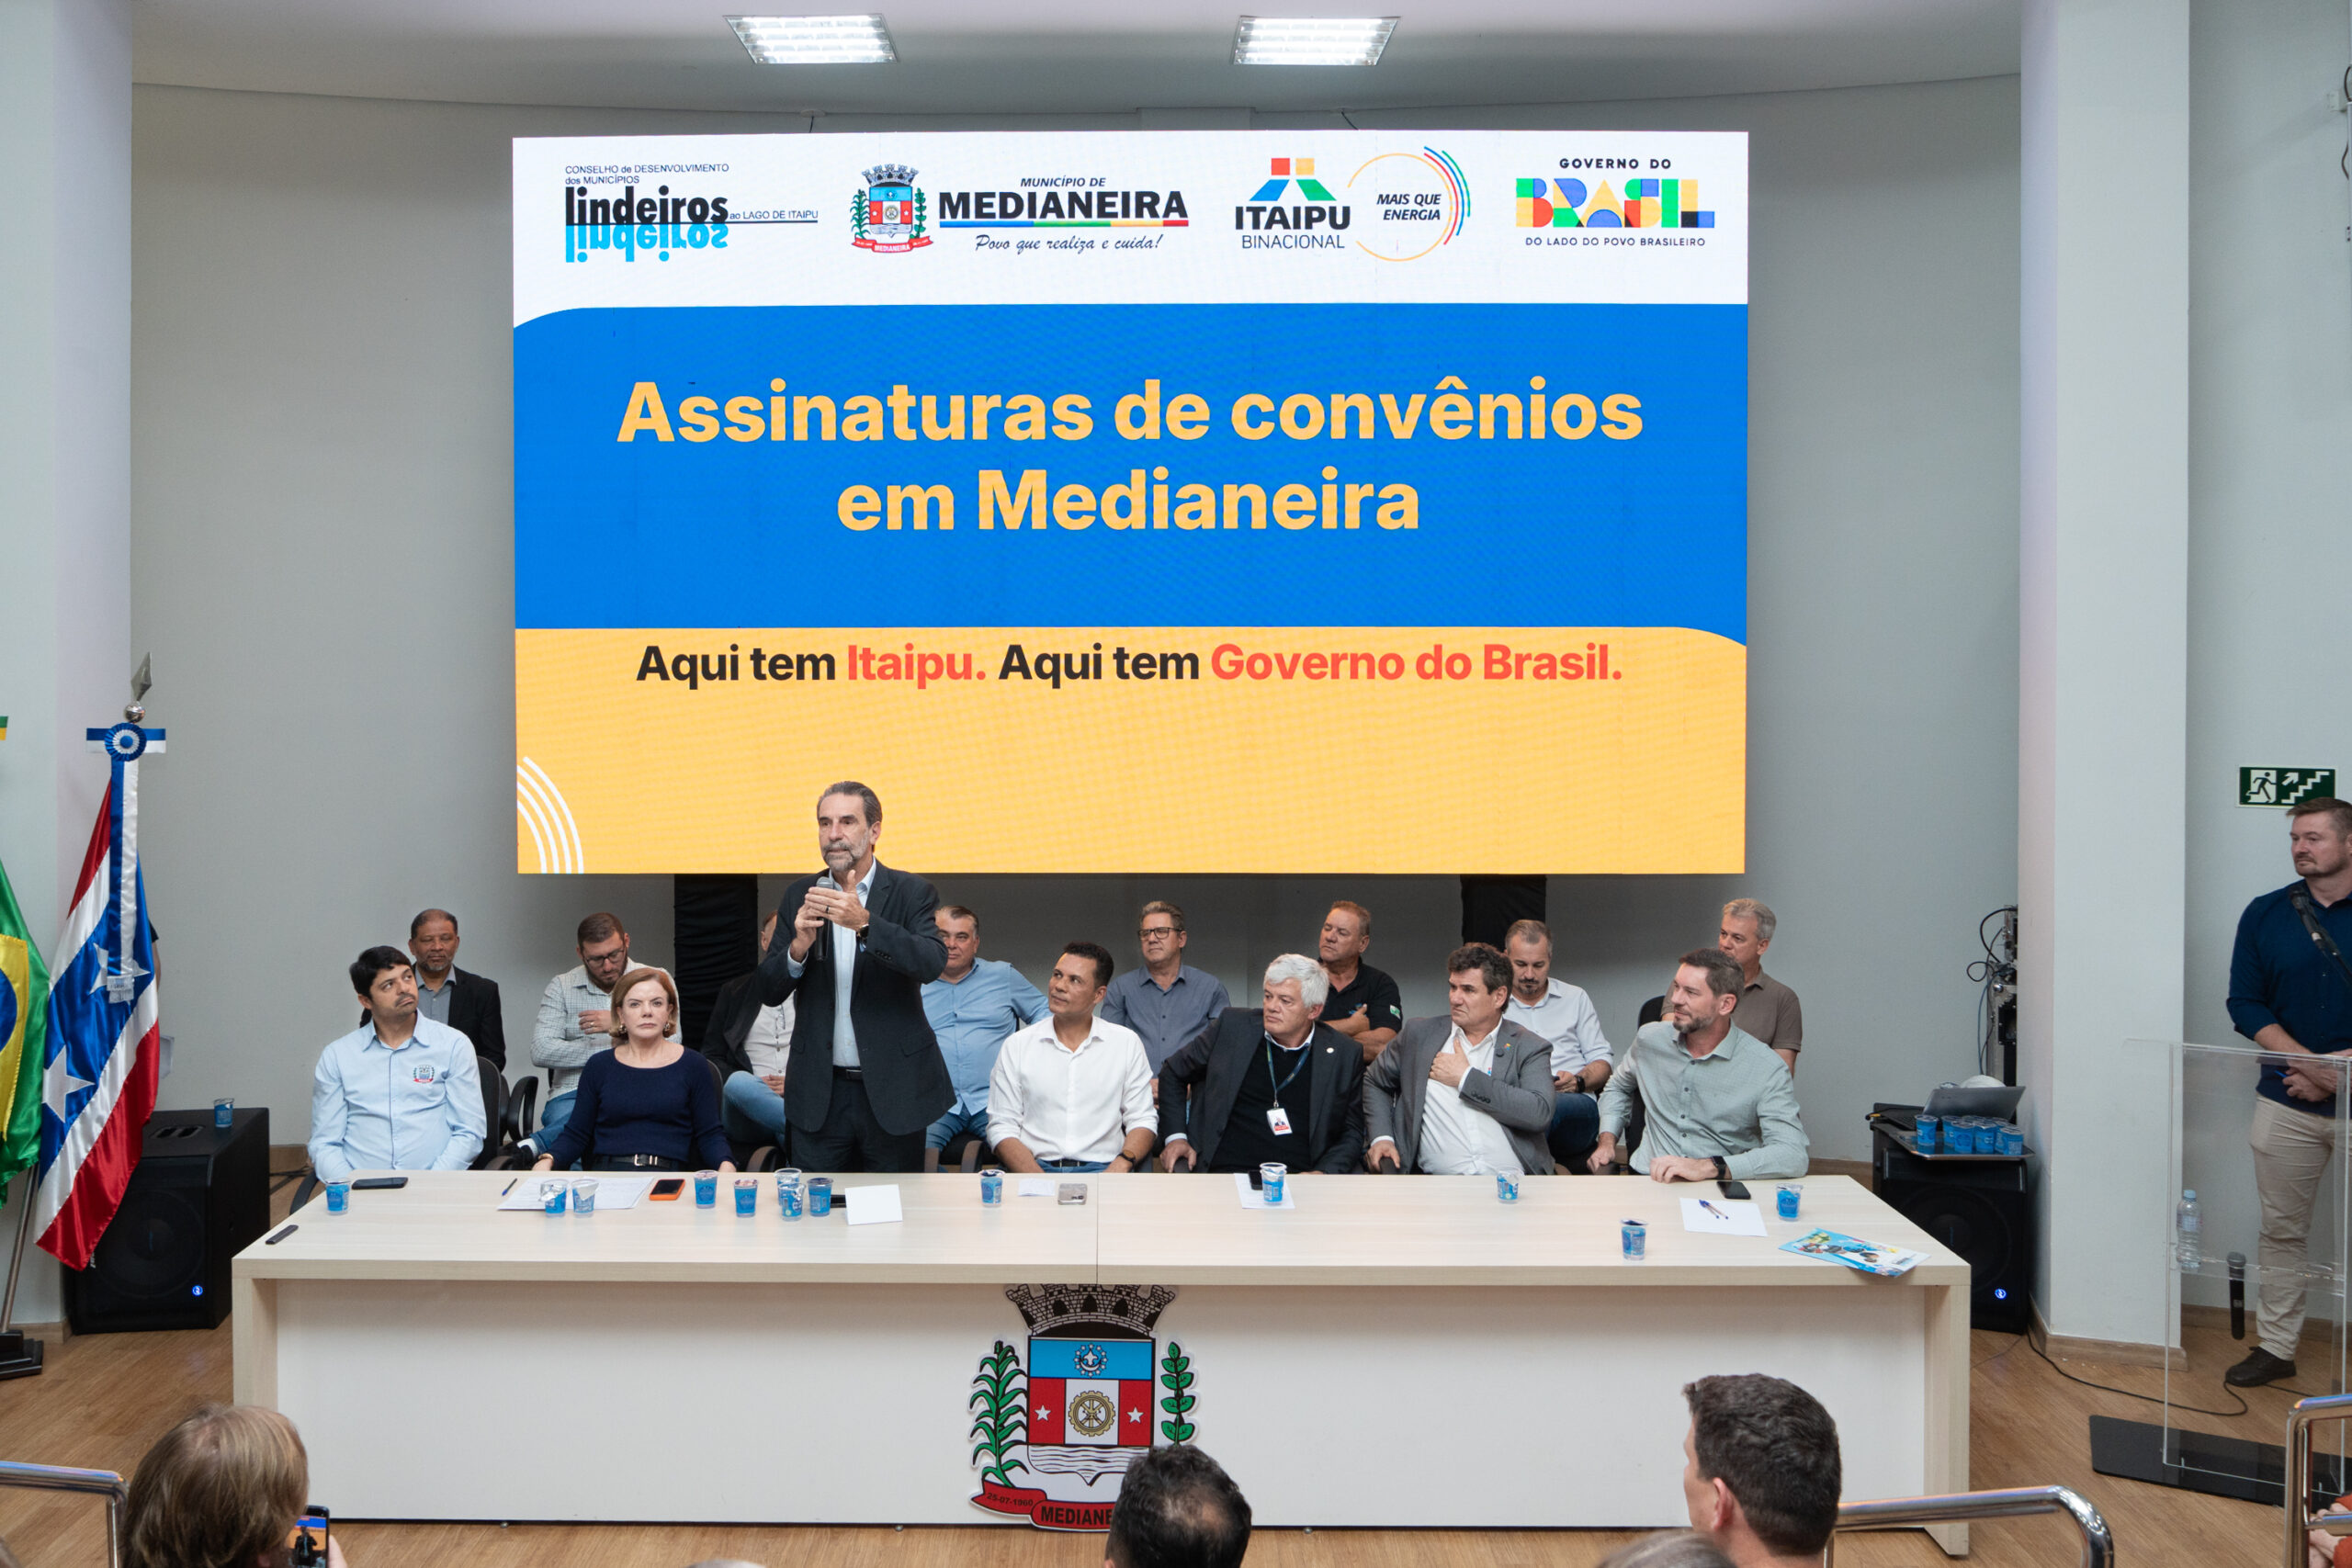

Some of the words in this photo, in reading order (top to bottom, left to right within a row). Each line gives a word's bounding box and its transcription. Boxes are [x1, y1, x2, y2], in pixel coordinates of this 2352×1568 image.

[565, 165, 618, 175] CONSELHO
[621, 165, 632, 174] de
[635, 164, 729, 173] DESENVOLVIMENTO
[1559, 158, 1639, 169] GOVERNO
[1650, 159, 1671, 169] DO
[565, 175, 581, 185] dos
[583, 174, 639, 185] MUNICÍPIOS
[1020, 175, 1085, 187] MUNICÍPIO
[1089, 177, 1106, 186] DE
[565, 185, 729, 224] lindeiros
[939, 191, 1188, 219] MEDIANEIRA
[1376, 193, 1410, 205] MAIS
[1414, 194, 1442, 206] QUE
[1516, 177, 1715, 229] BRASIL
[743, 210, 770, 220] LAGO
[773, 210, 786, 220] DE
[788, 210, 818, 220] ITAIPU
[1236, 206, 1351, 230] ITAIPU
[1383, 207, 1441, 220] ENERGIA
[975, 234, 1010, 251] Povo
[1016, 241, 1041, 255] que
[1046, 235, 1095, 254] realiza
[1102, 240, 1109, 249] e
[1114, 234, 1164, 249] cuida!
[1242, 234, 1345, 249] BINACIONAL
[1525, 237, 1542, 245] DO
[1547, 237, 1577, 246] LADO
[1583, 237, 1599, 245] DO
[1604, 237, 1635, 246] POVO
[1640, 238, 1705, 246] BRASILEIRO
[617, 378, 1093, 442] Assinaturas
[1114, 379, 1210, 440] de
[1231, 376, 1643, 440] convênios
[838, 485, 954, 531] em
[978, 466, 1419, 530] Medianeira
[636, 643, 739, 690] Aqui
[750, 648, 835, 681] tem
[849, 643, 985, 689] Itaipu.
[999, 642, 1102, 689] Aqui
[1113, 647, 1199, 680] tem
[1212, 644, 1405, 680] Governo
[1416, 645, 1472, 680] do
[1485, 643, 1622, 680] Brasil.
[987, 1492, 1034, 1506] 25-07-1960
[1041, 1506, 1113, 1526] MEDIANE
